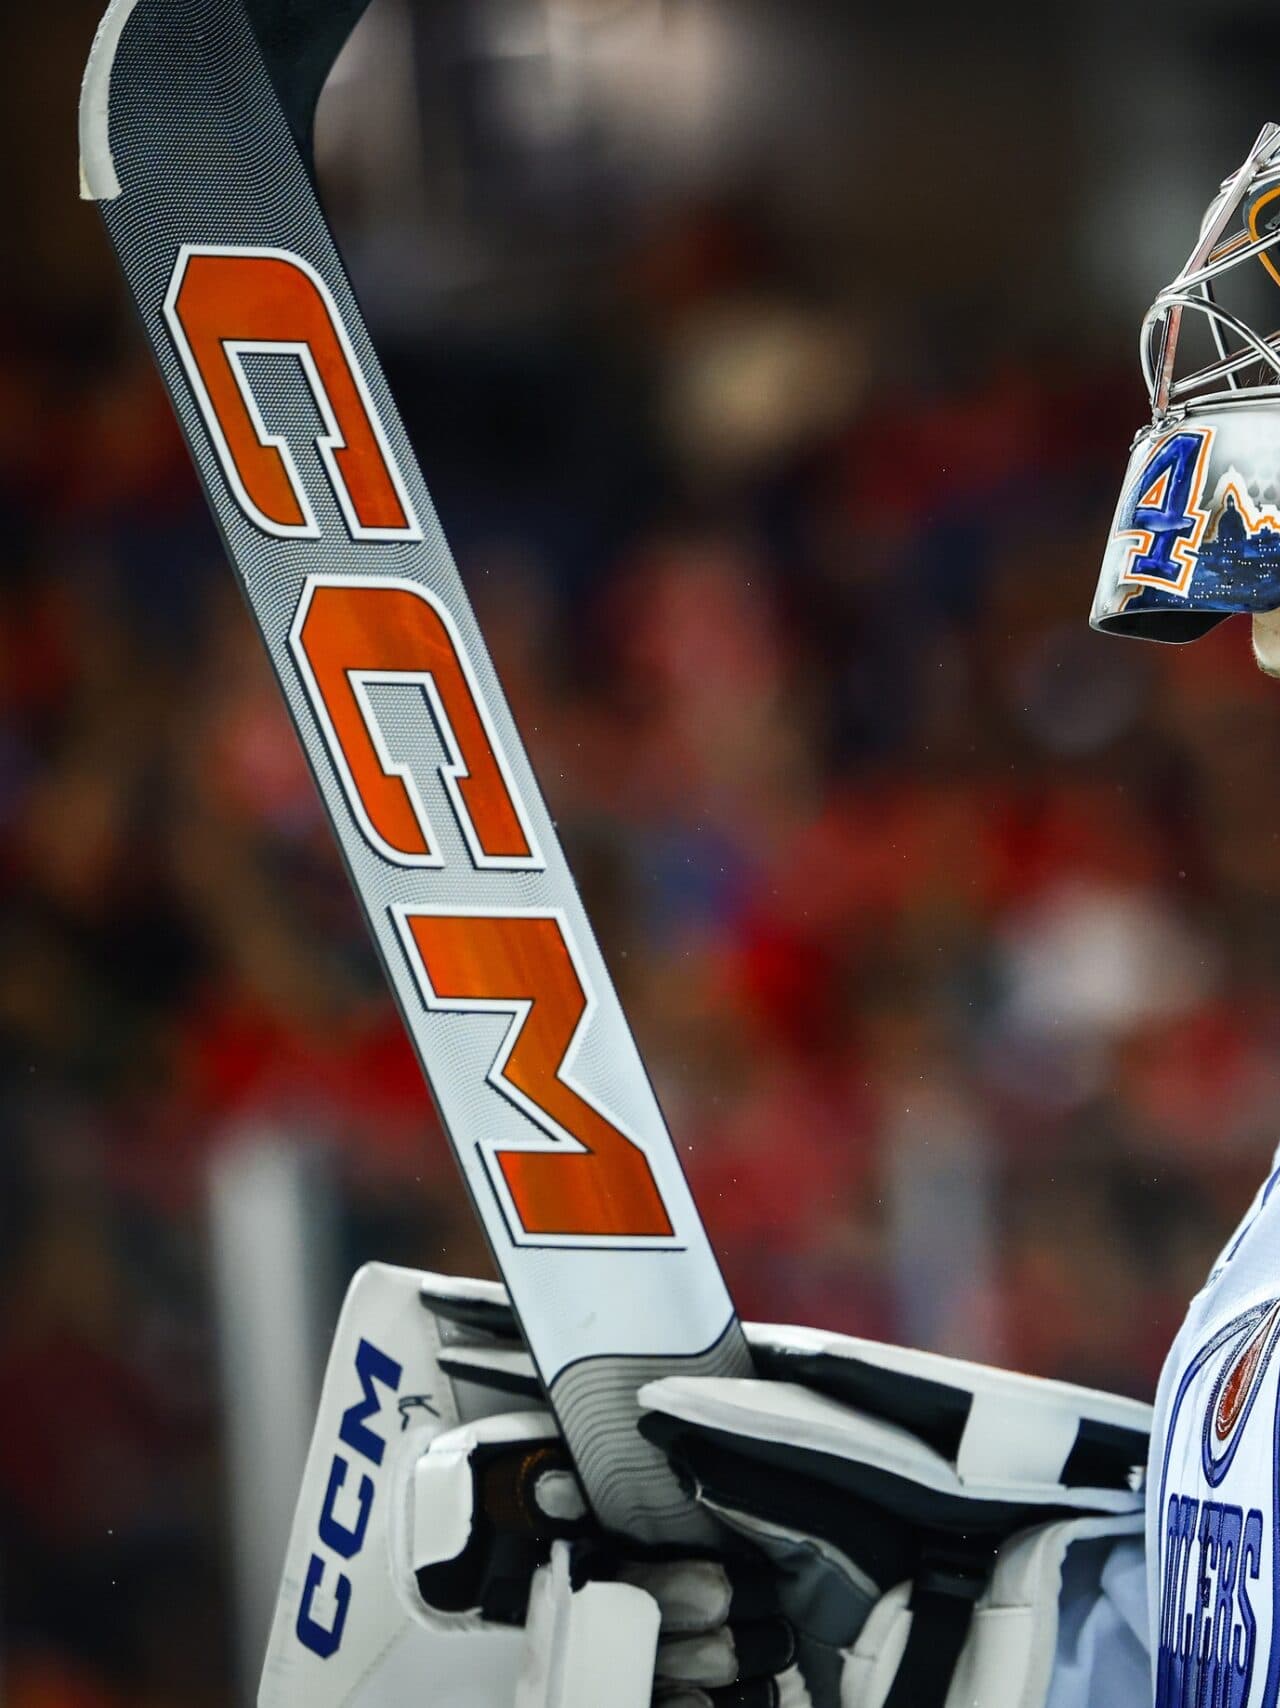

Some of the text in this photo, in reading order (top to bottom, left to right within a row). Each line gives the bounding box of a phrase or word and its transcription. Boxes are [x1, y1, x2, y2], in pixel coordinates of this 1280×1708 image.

[1114, 427, 1216, 597] 4
[163, 244, 687, 1250] CCM
[295, 1338, 403, 1660] CCM
